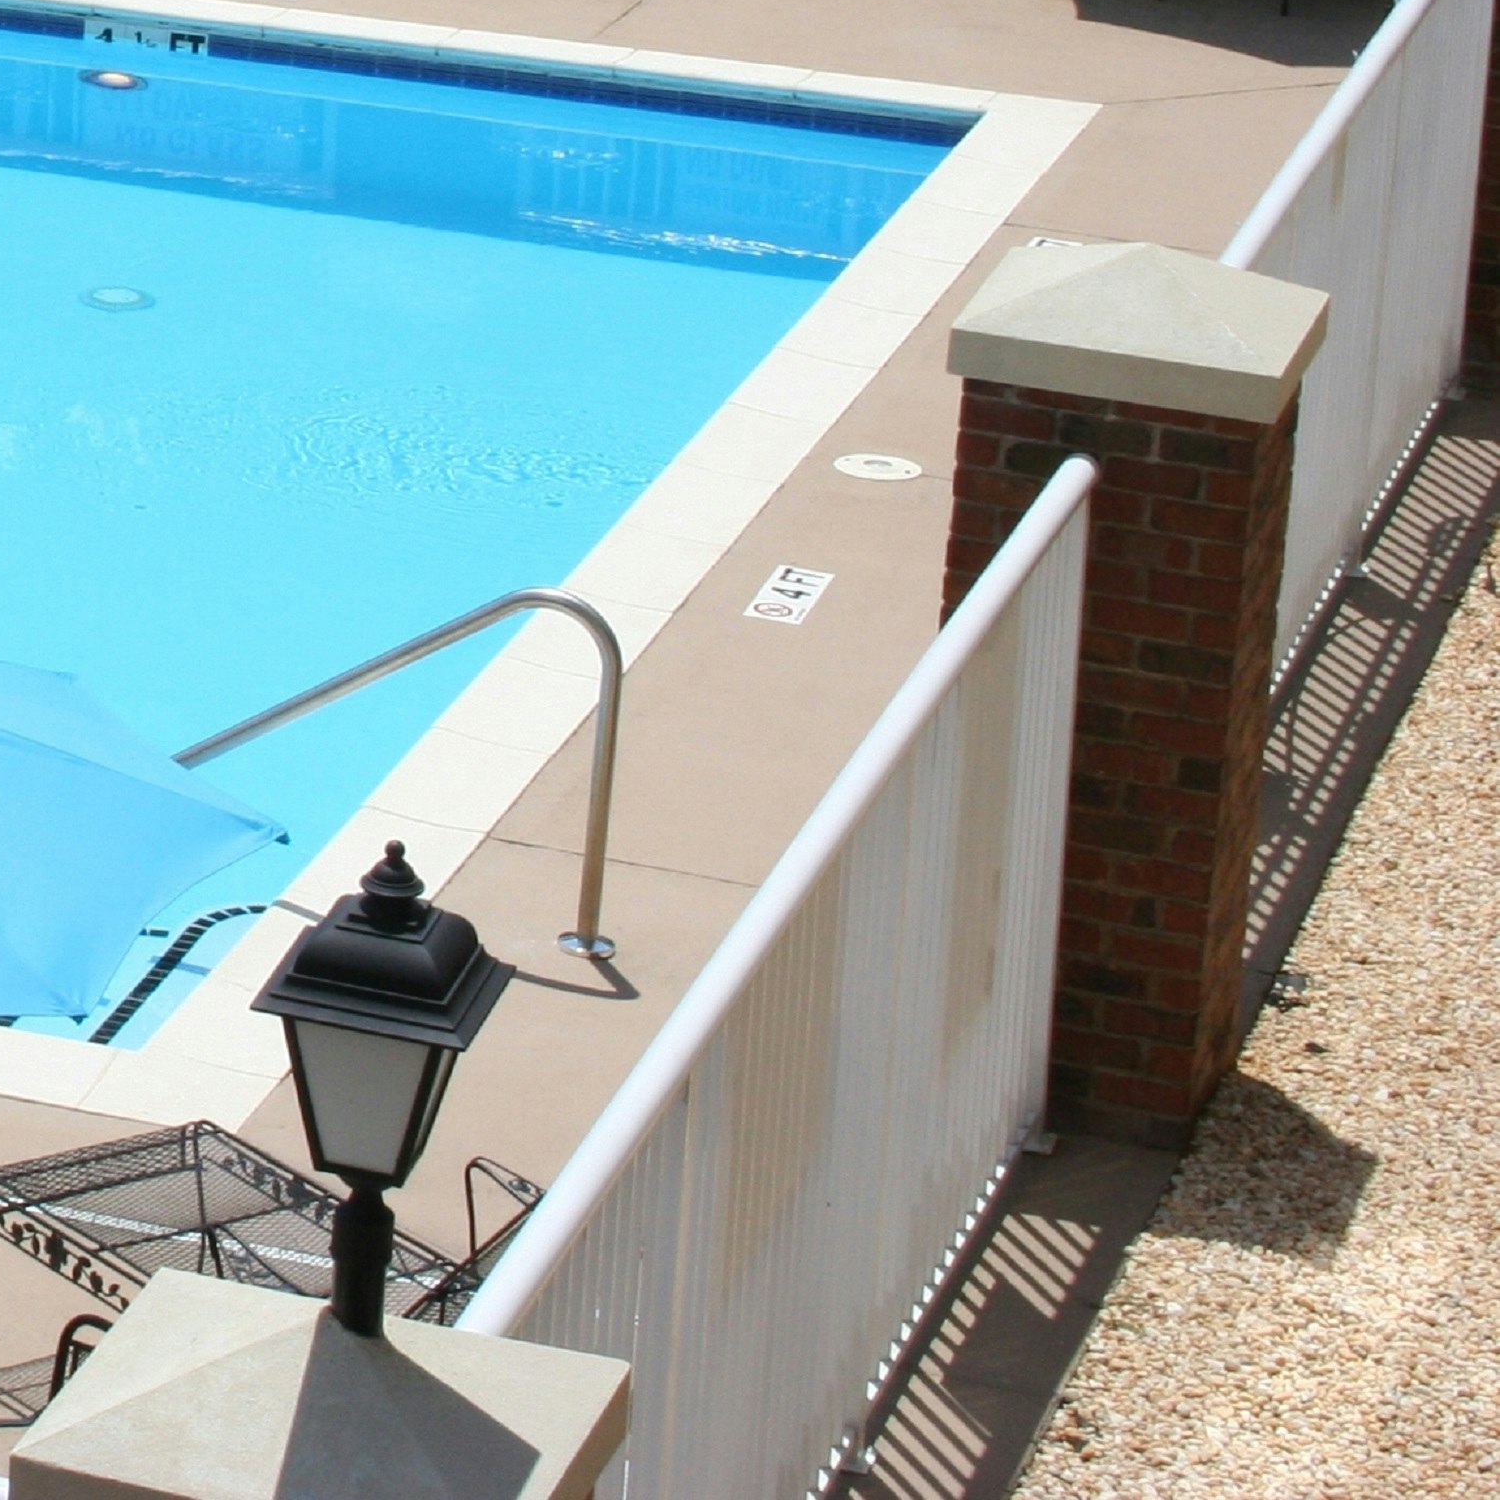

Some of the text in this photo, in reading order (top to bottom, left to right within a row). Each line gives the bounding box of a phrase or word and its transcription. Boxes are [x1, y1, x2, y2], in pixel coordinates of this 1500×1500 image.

[169, 31, 206, 55] FT
[770, 568, 825, 599] 4 FT
